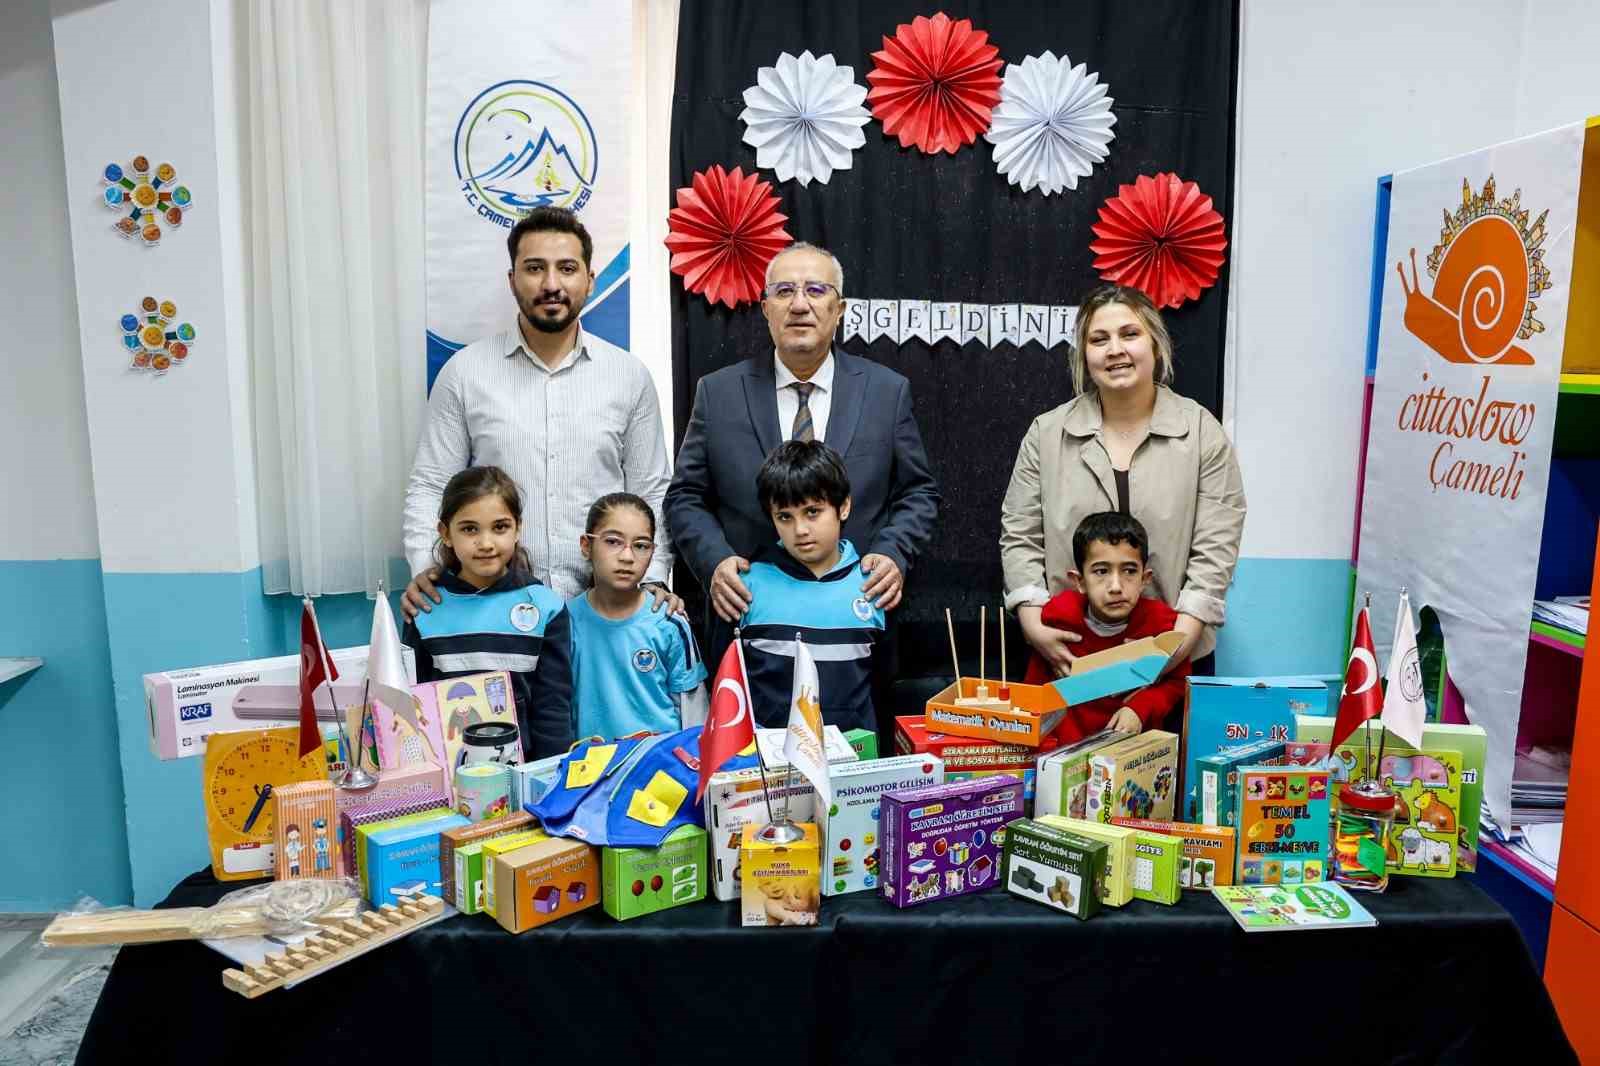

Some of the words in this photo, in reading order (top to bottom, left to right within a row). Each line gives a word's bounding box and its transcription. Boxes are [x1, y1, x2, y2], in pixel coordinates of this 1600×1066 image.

[461, 182, 477, 208] T.C.
[1398, 372, 1536, 446] cittaslow
[1429, 441, 1527, 500] Çameli
[177, 680, 225, 694] Laminasyon
[226, 673, 260, 687] Makinesi
[181, 703, 212, 719] KRAF
[930, 708, 985, 728] Matematik
[1226, 722, 1249, 739] 5N
[1270, 724, 1289, 740] 1K
[241, 752, 249, 760] 11
[261, 744, 271, 753] 12
[966, 756, 998, 766] SOSYAL
[224, 768, 236, 776] 10
[836, 783, 898, 798] PSİKOMOTOR
[900, 776, 935, 789] GELİŞİM
[847, 797, 876, 807] KODLAMA
[911, 814, 953, 832] KAVRAM
[952, 806, 994, 823] ÖĞRETİM
[1261, 804, 1311, 820] TEMEL
[1274, 823, 1296, 839] 50
[1184, 836, 1223, 849] KAVRAMI
[1014, 845, 1031, 859] Sert
[1039, 852, 1080, 875] Yumuşak
